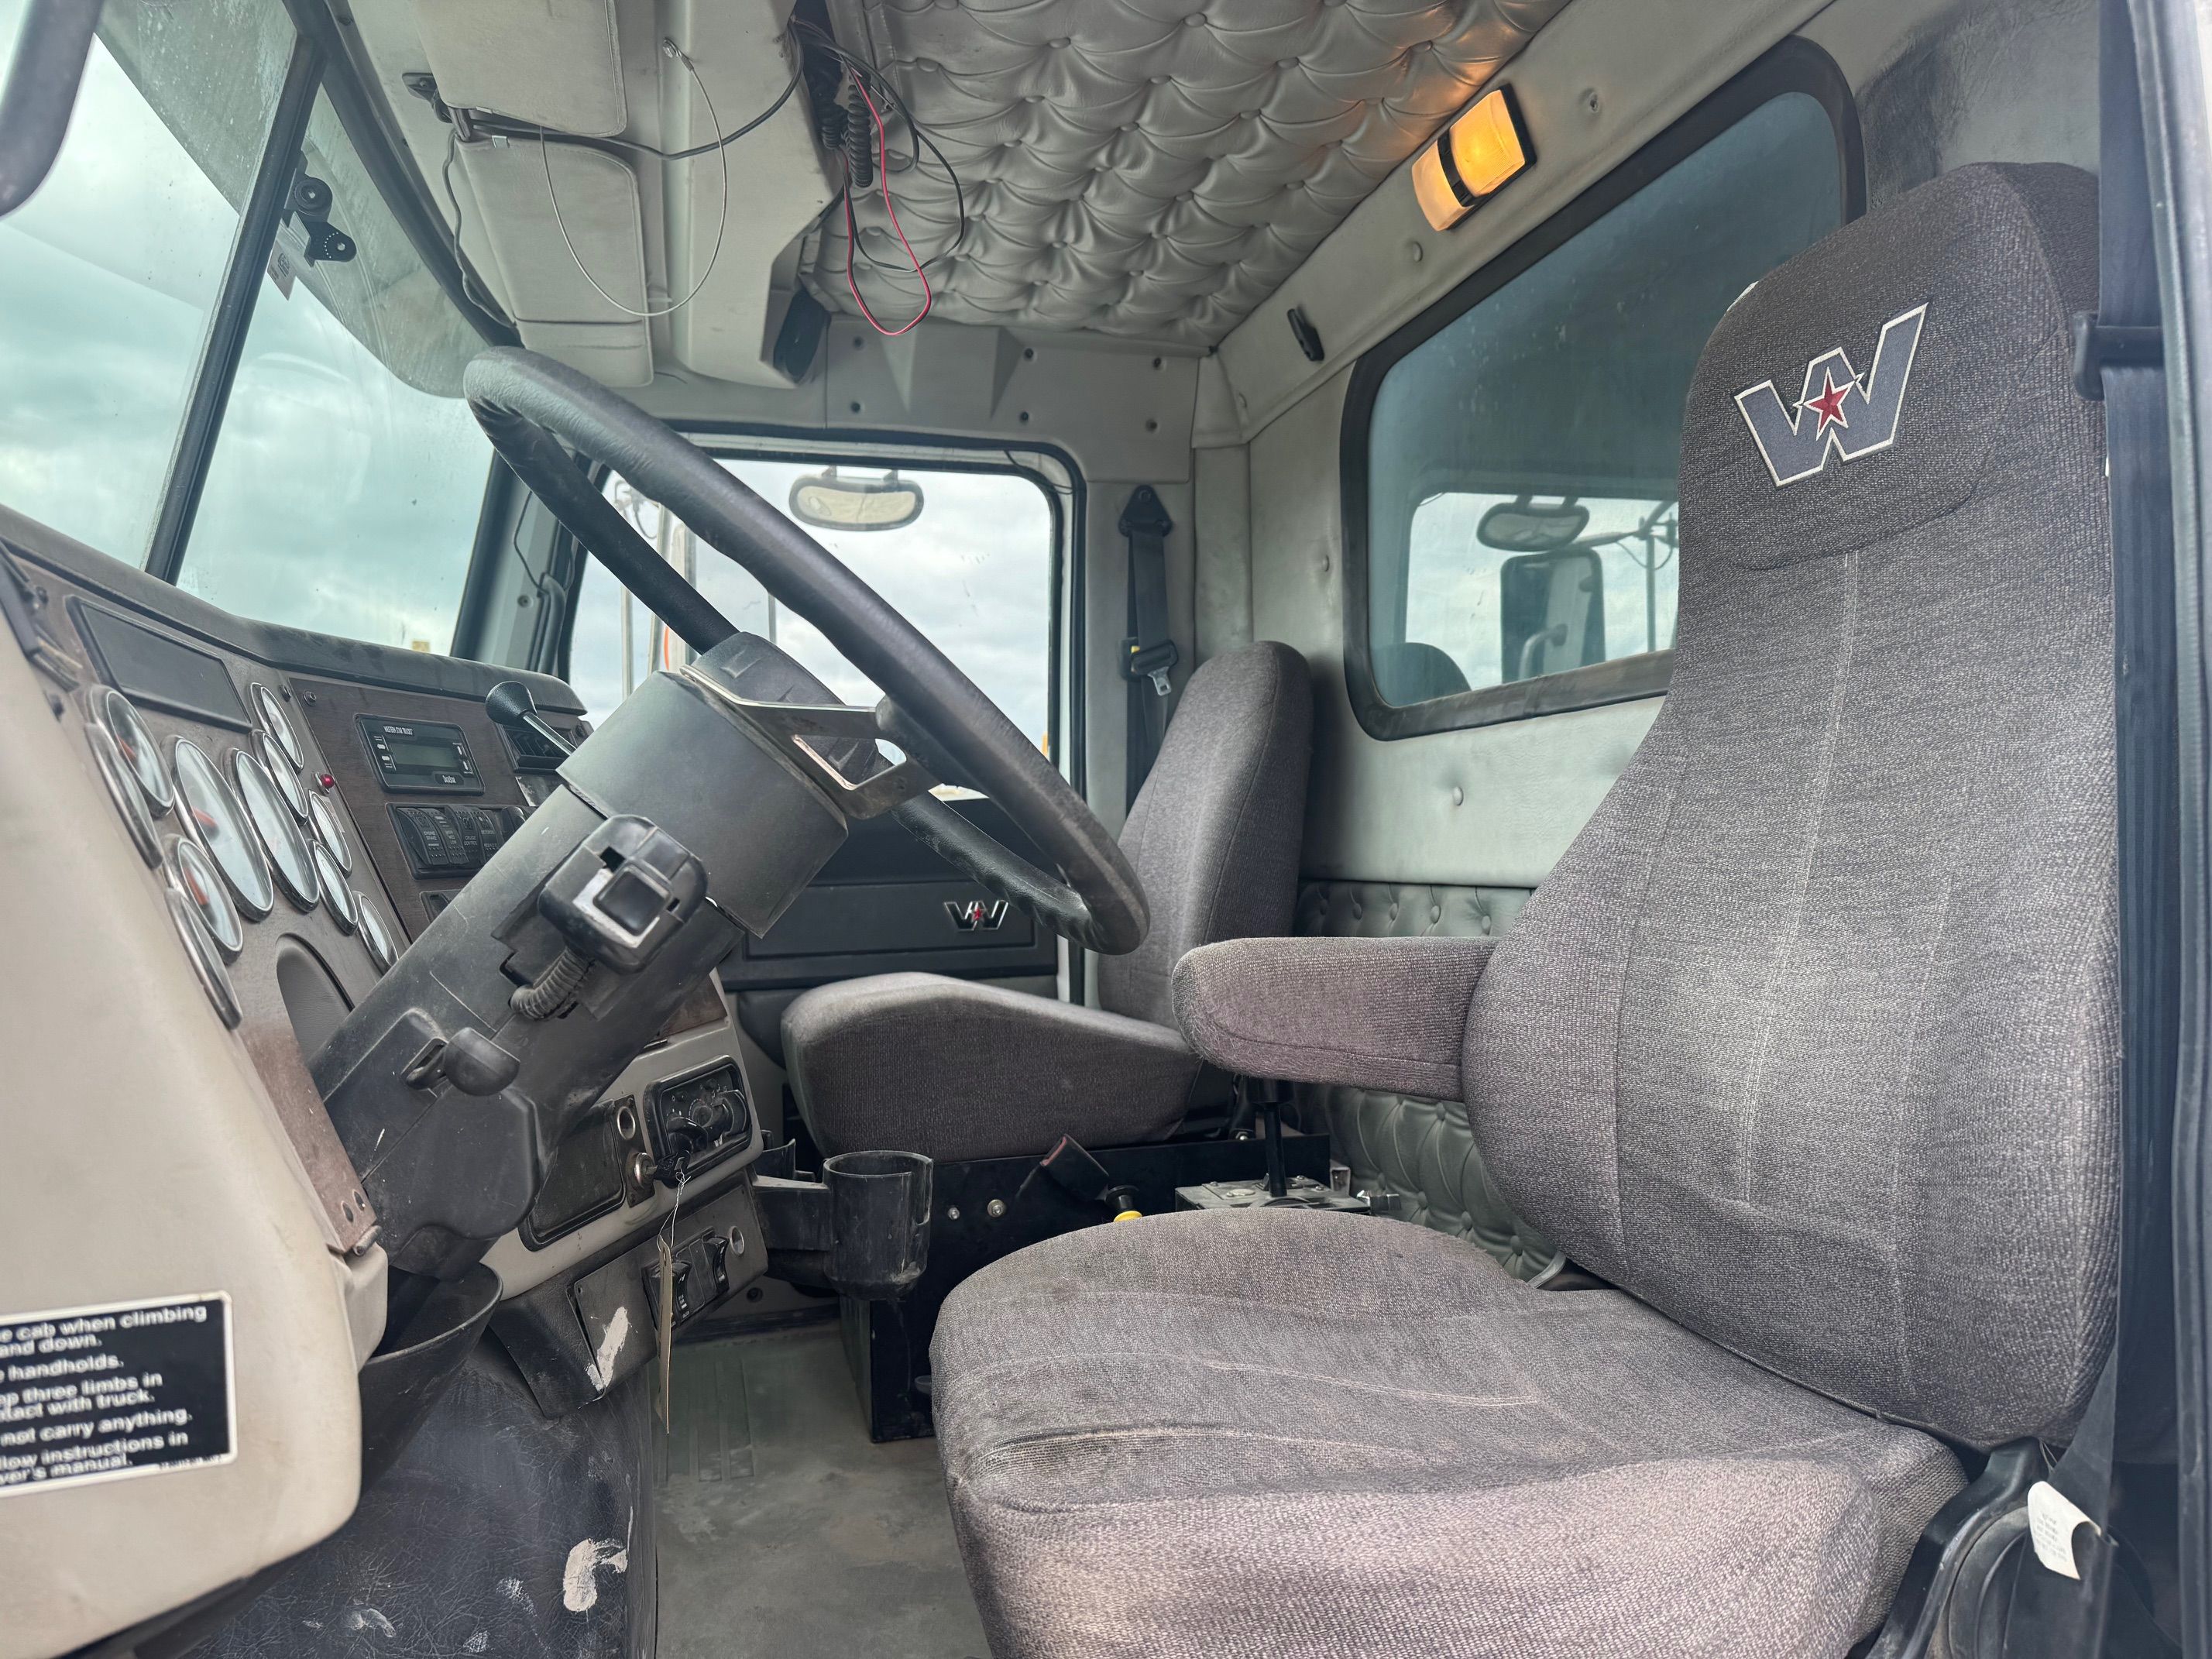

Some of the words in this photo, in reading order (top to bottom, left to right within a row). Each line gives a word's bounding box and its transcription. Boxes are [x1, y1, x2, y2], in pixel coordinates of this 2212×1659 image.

[16, 1322, 56, 1341] cab
[60, 1317, 116, 1336] when
[119, 1306, 208, 1328] climbing
[39, 1334, 102, 1354] down.
[8, 1354, 124, 1382] handholds.
[22, 1385, 78, 1403] three
[81, 1376, 139, 1396] limbs
[142, 1371, 163, 1389] in
[47, 1396, 92, 1416] with
[97, 1389, 154, 1410] truck.
[1, 1427, 36, 1447] not
[40, 1422, 94, 1441] carry
[98, 1408, 193, 1433] anything.
[41, 1434, 165, 1465] instructions
[168, 1431, 188, 1447] in
[50, 1453, 133, 1477] manual.
